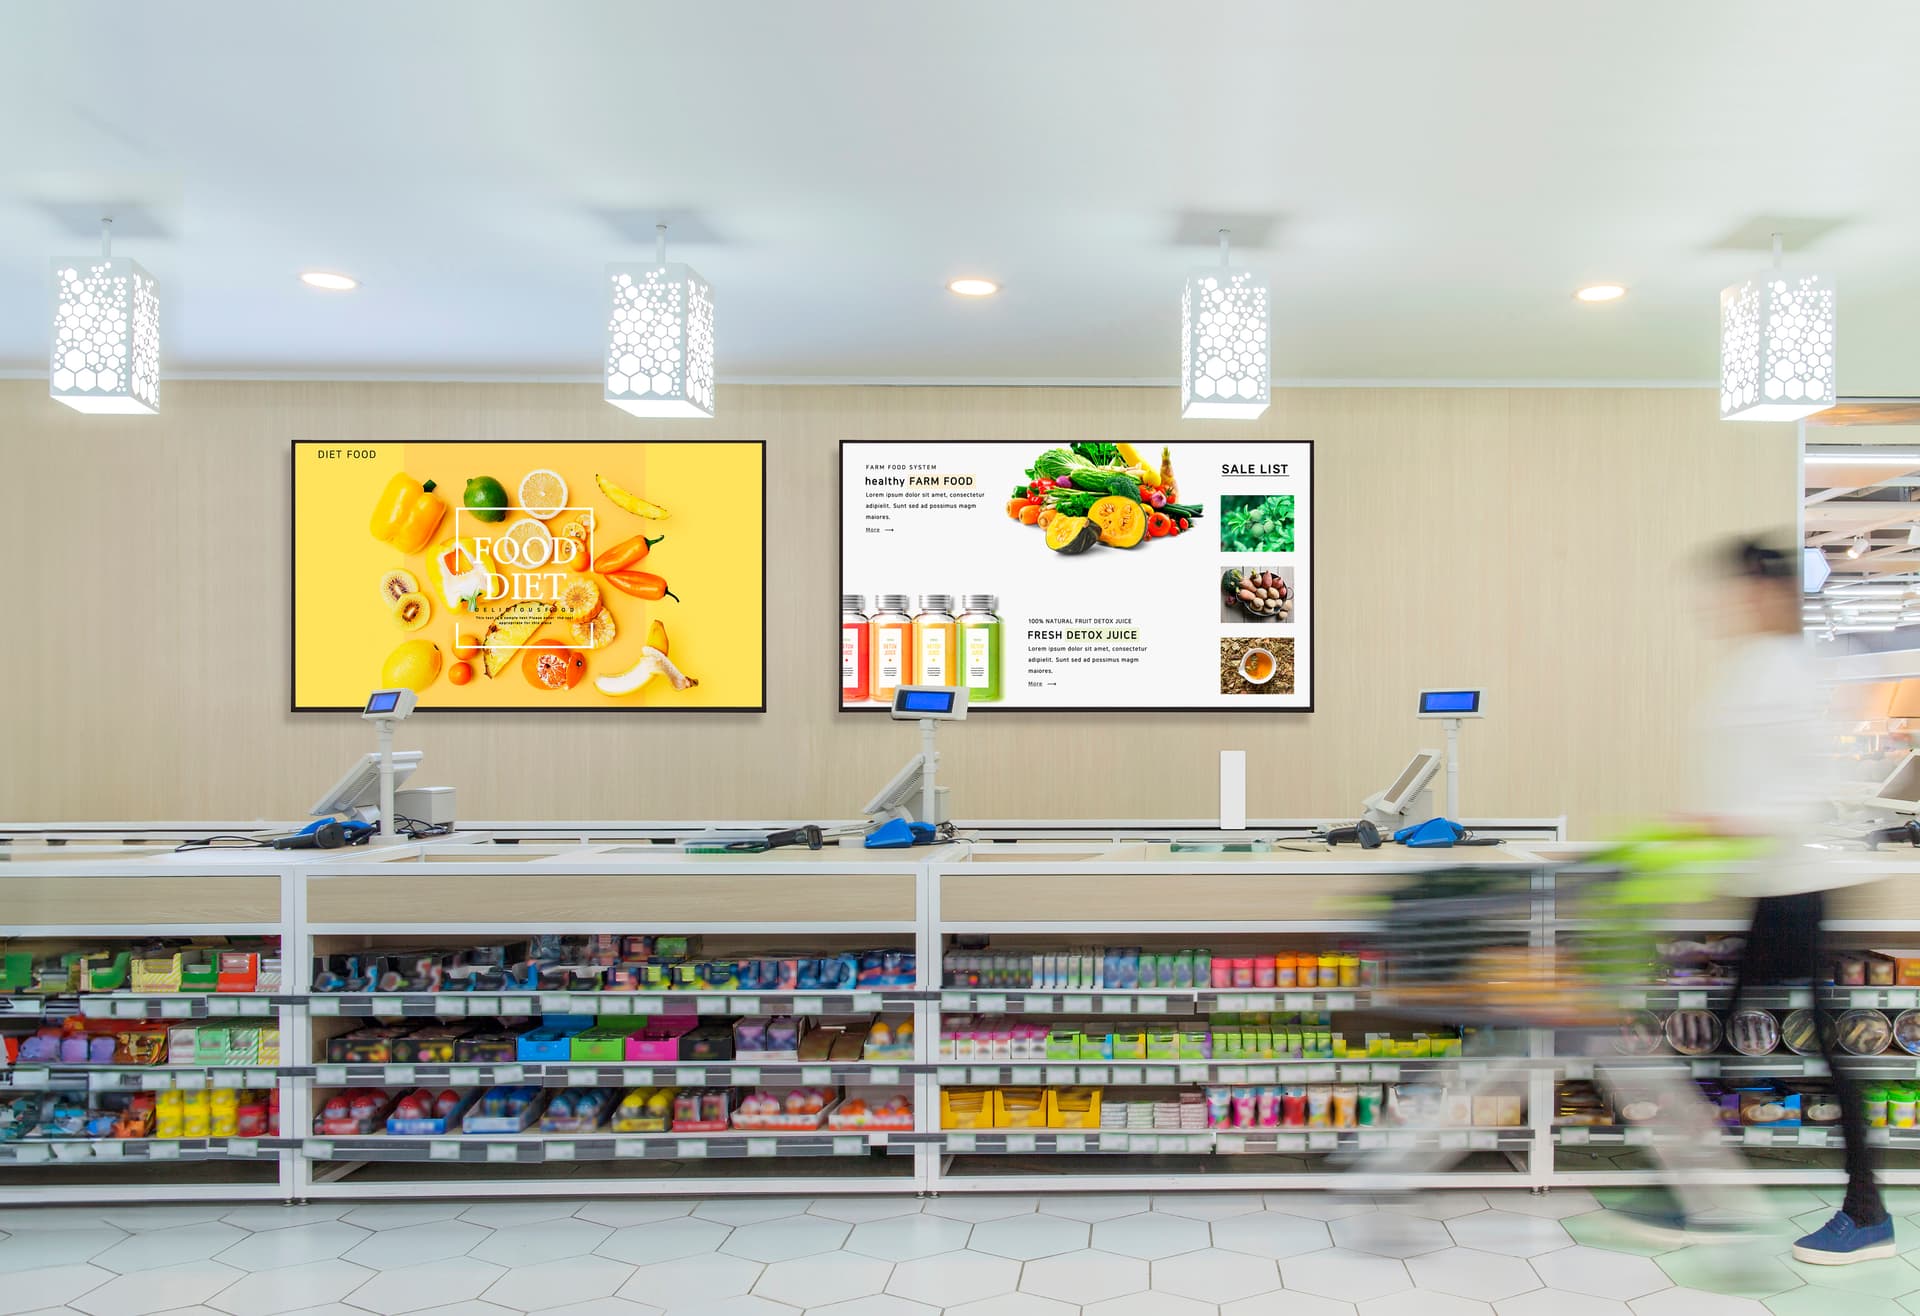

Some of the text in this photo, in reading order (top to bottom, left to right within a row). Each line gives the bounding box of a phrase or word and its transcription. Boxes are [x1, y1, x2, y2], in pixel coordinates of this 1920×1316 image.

[318, 450, 376, 458] DIET FOOD
[1222, 464, 1288, 474] SALE LIST
[865, 477, 973, 487] healthy FARM FOOD
[473, 536, 577, 564] FOOD
[484, 573, 567, 600] DIET
[1028, 631, 1137, 639] FRESH DETOX JUICE
